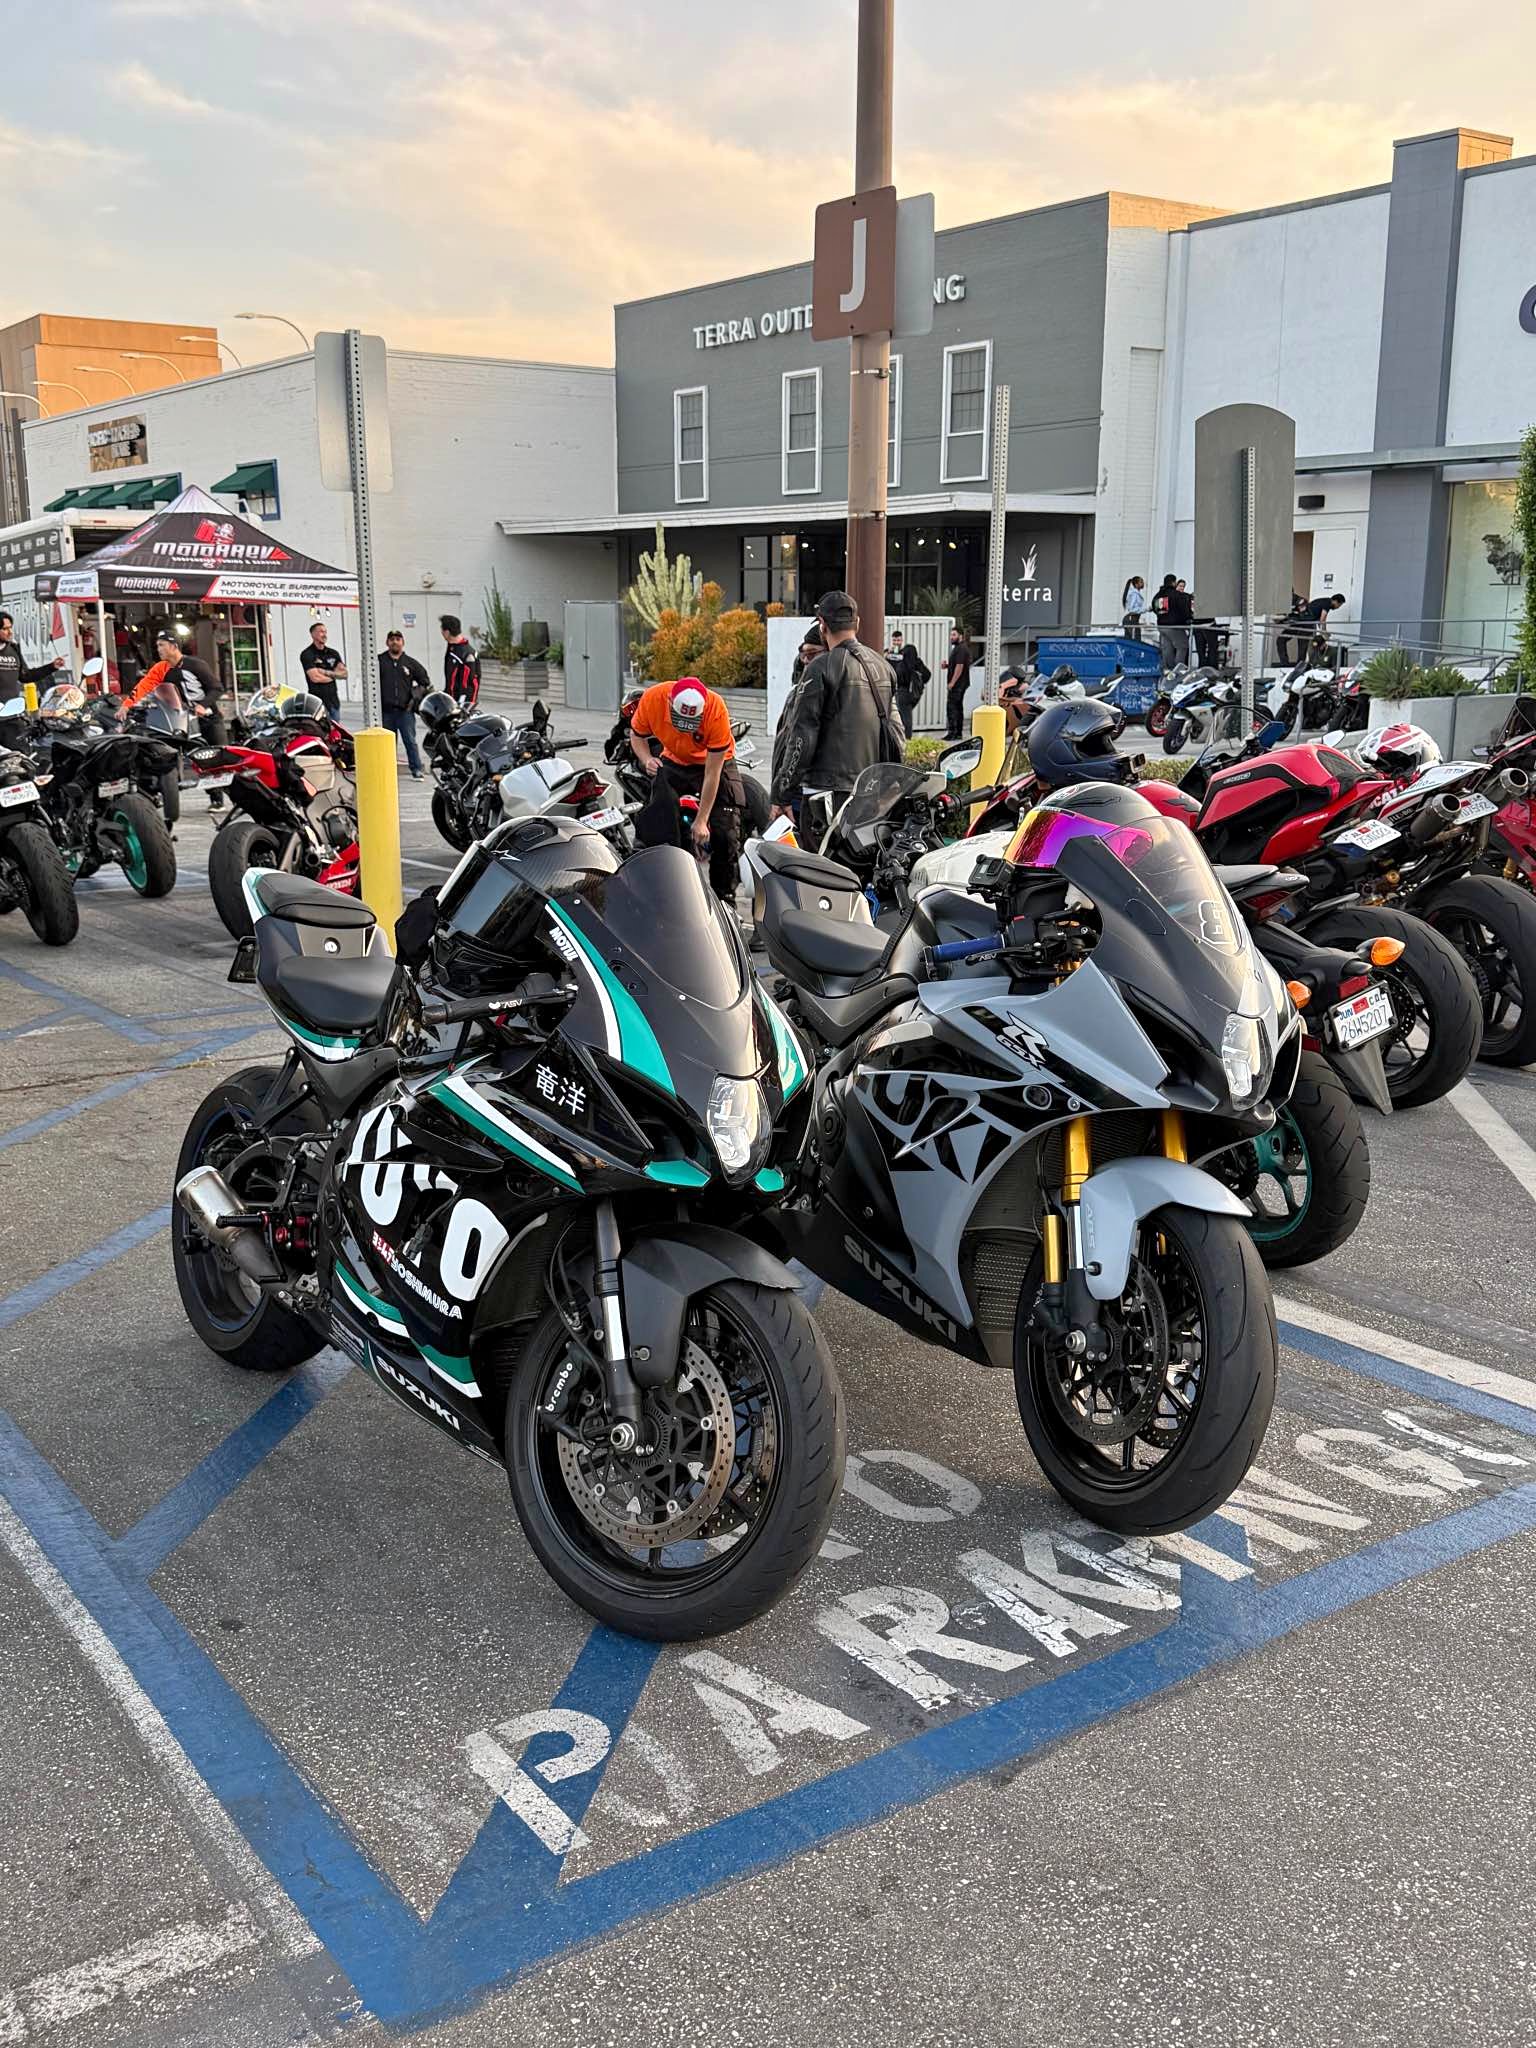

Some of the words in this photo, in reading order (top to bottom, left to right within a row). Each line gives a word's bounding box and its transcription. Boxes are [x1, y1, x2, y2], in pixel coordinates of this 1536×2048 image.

[840, 218, 868, 313] J
[693, 317, 757, 349] TERRA
[761, 304, 813, 337] OUTD
[220, 581, 286, 591] MOTORCYCLE
[289, 583, 349, 592] SUSPENSION
[220, 589, 256, 597] TUNING
[283, 592, 321, 600] SERVICE
[1003, 584, 1053, 602] terra
[680, 703, 697, 716] 58
[549, 926, 579, 962] MOTUL
[536, 1064, 587, 1116] 竜洋
[391, 1254, 463, 1320] YOSHIMURA
[844, 1234, 957, 1343] SUZUKI
[376, 1355, 460, 1431] SUZUKI
[545, 1363, 573, 1412] brembo
[464, 1427, 1484, 1856] PARKING
